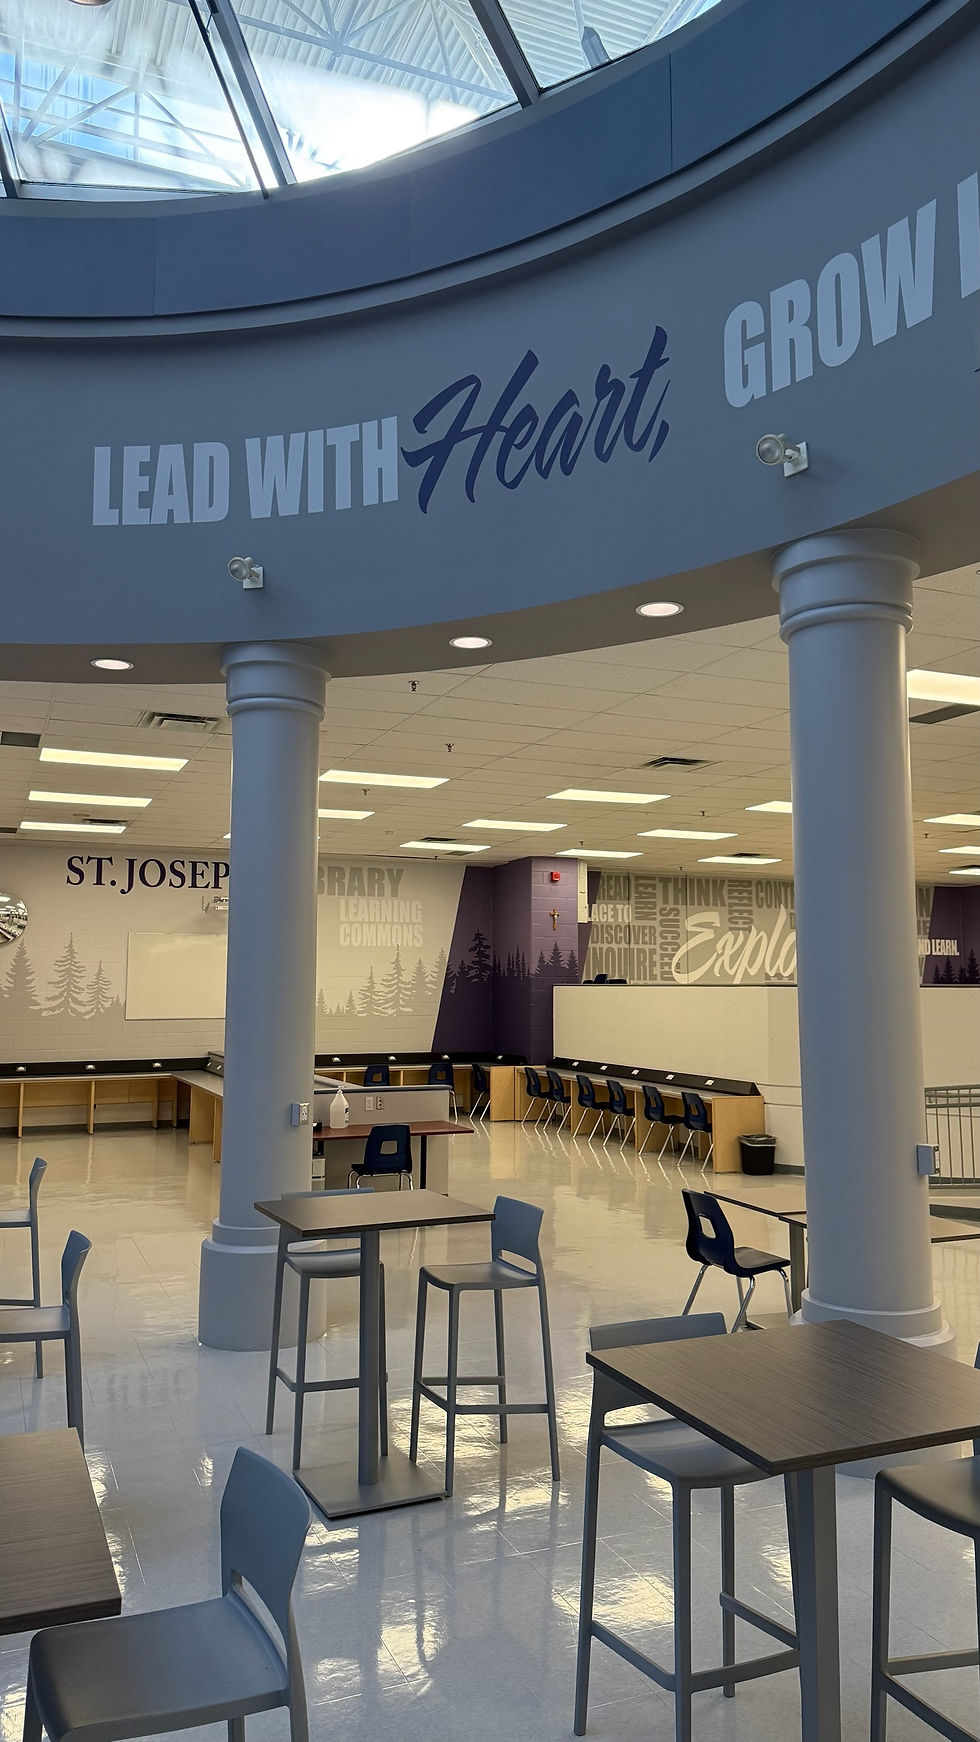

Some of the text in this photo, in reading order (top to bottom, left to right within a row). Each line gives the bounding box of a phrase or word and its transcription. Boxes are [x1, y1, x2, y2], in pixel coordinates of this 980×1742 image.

[723, 198, 936, 408] GROW
[92, 325, 671, 526] LEAD WITH Heart,
[66, 855, 117, 887] ST.
[634, 875, 657, 921] LEARN
[659, 876, 727, 907] THINK
[727, 879, 754, 934] REFLECT
[341, 899, 422, 924] LEARNING
[340, 923, 423, 947] COMMONS
[591, 924, 657, 945] DISCOVER
